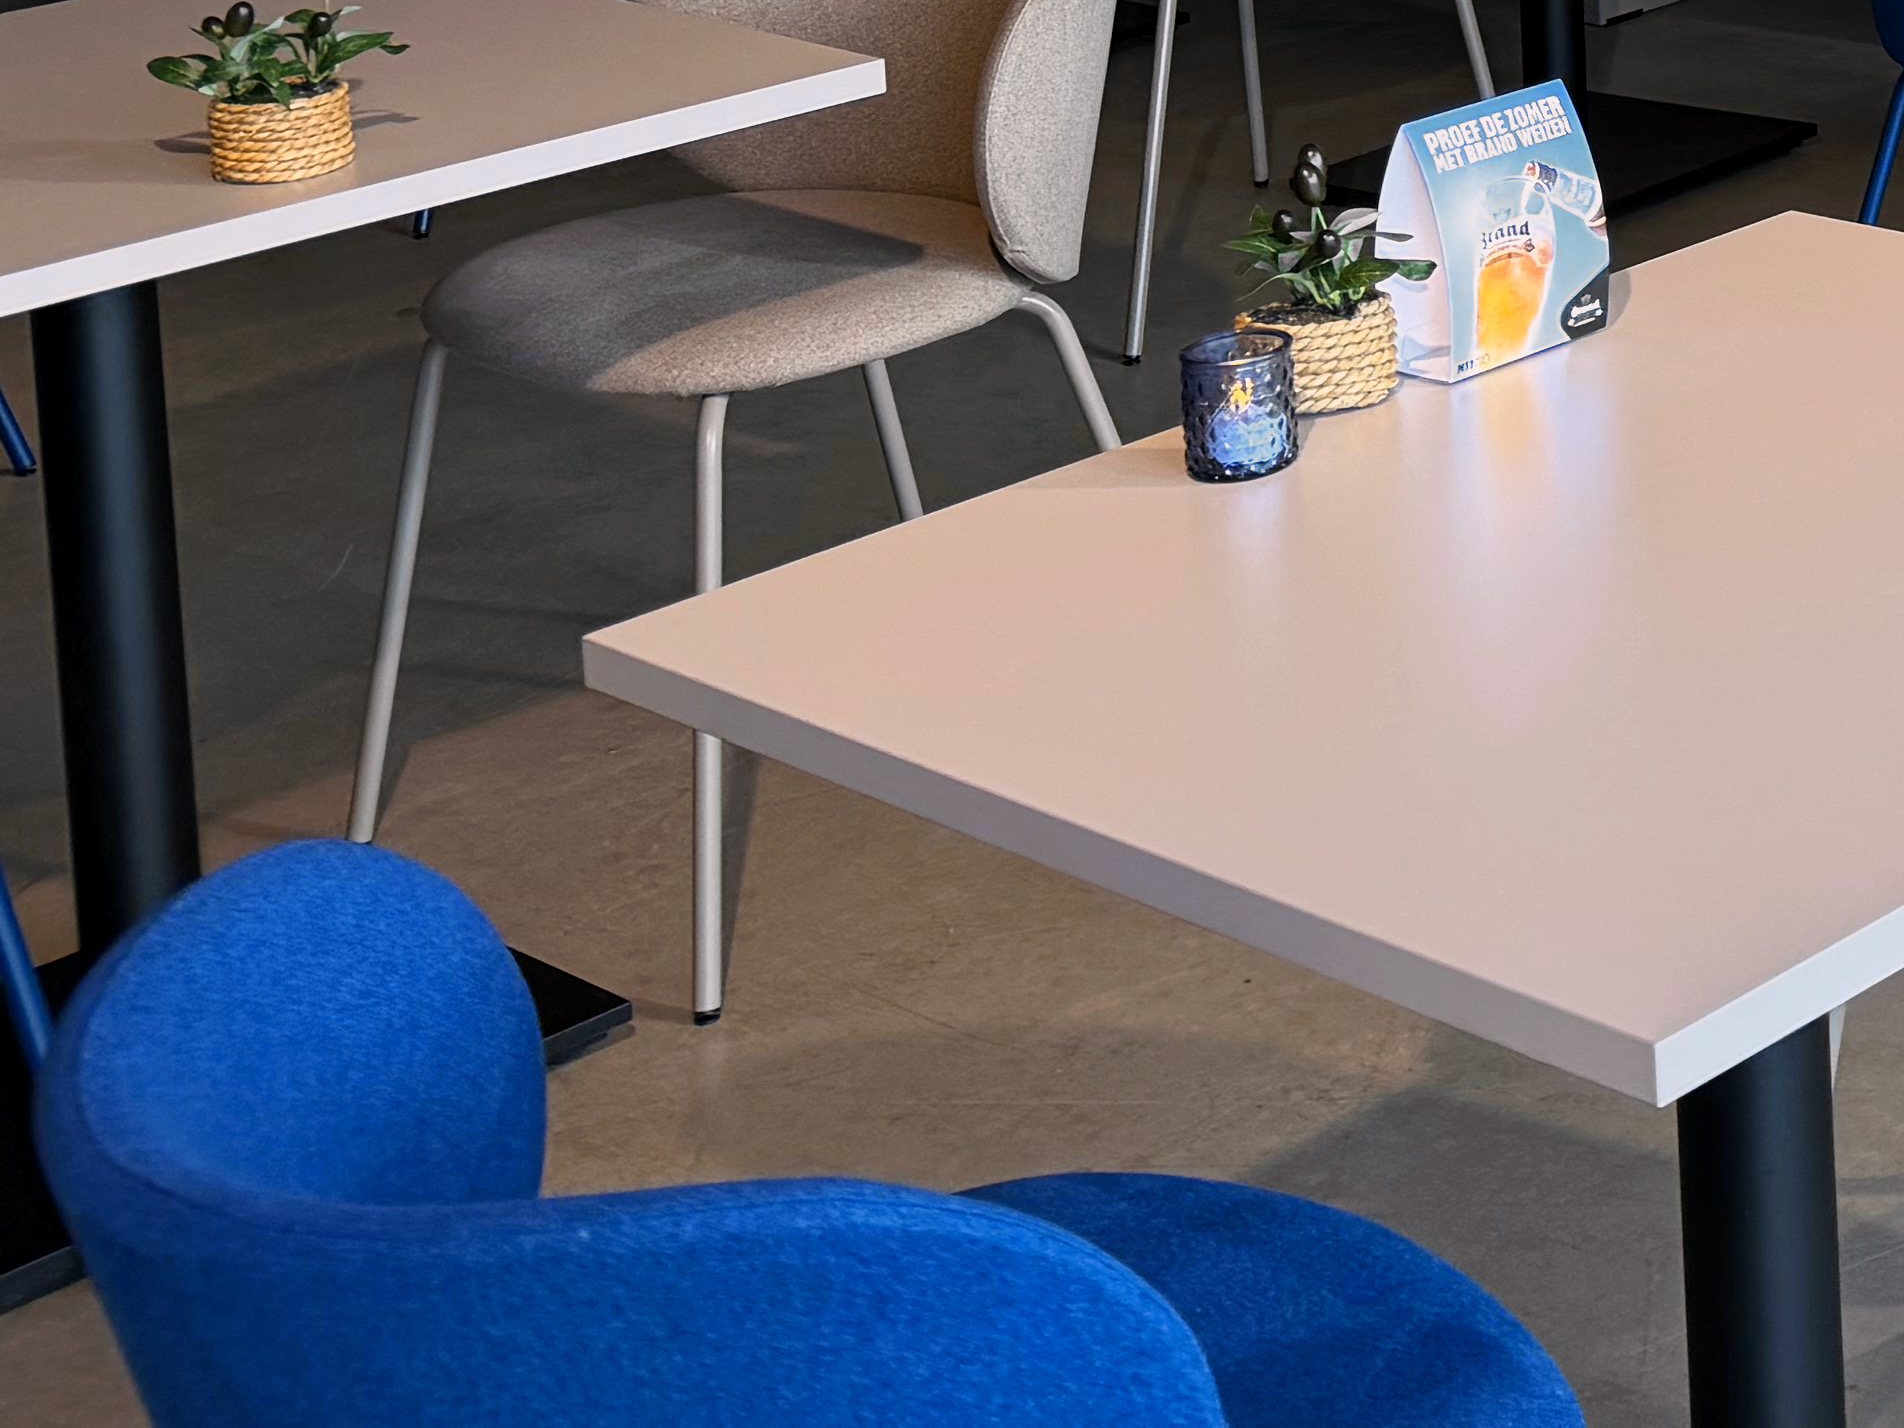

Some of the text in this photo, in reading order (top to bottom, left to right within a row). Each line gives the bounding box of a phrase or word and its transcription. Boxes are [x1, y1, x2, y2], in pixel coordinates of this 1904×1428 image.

[1423, 95, 1565, 155] PROEF DE ZOMER
[1433, 116, 1572, 174] MET BRAND WEIZEN
